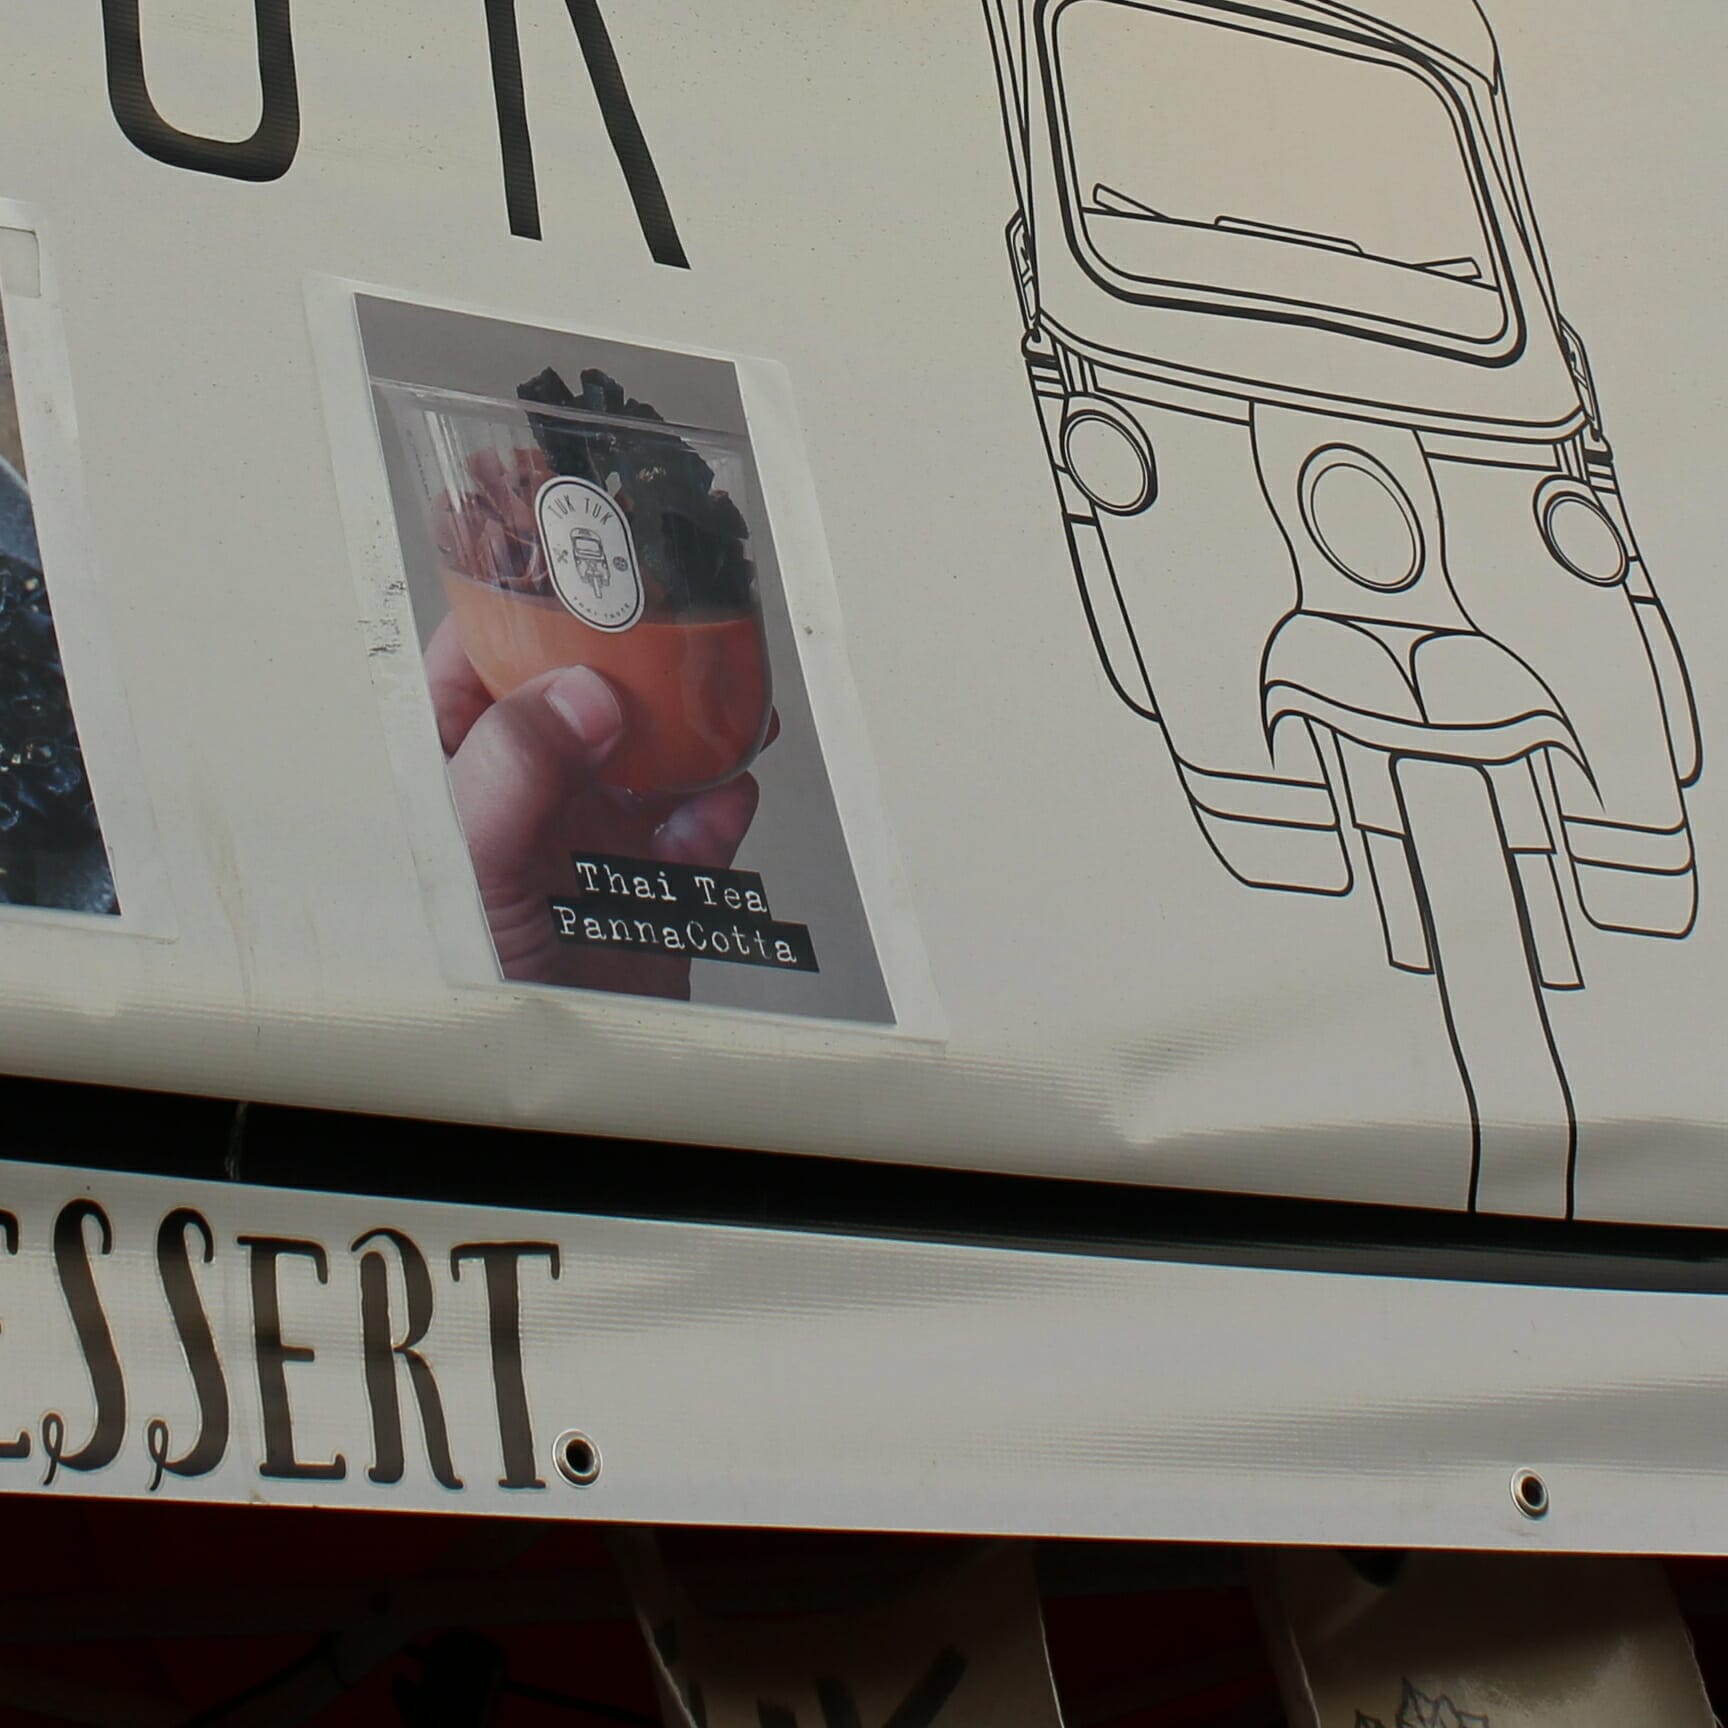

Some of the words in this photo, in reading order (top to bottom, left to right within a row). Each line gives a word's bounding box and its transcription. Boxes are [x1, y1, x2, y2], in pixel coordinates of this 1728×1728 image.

[575, 861, 678, 901] Thai
[694, 875, 768, 913] Tea
[553, 905, 798, 964] PannaCotta
